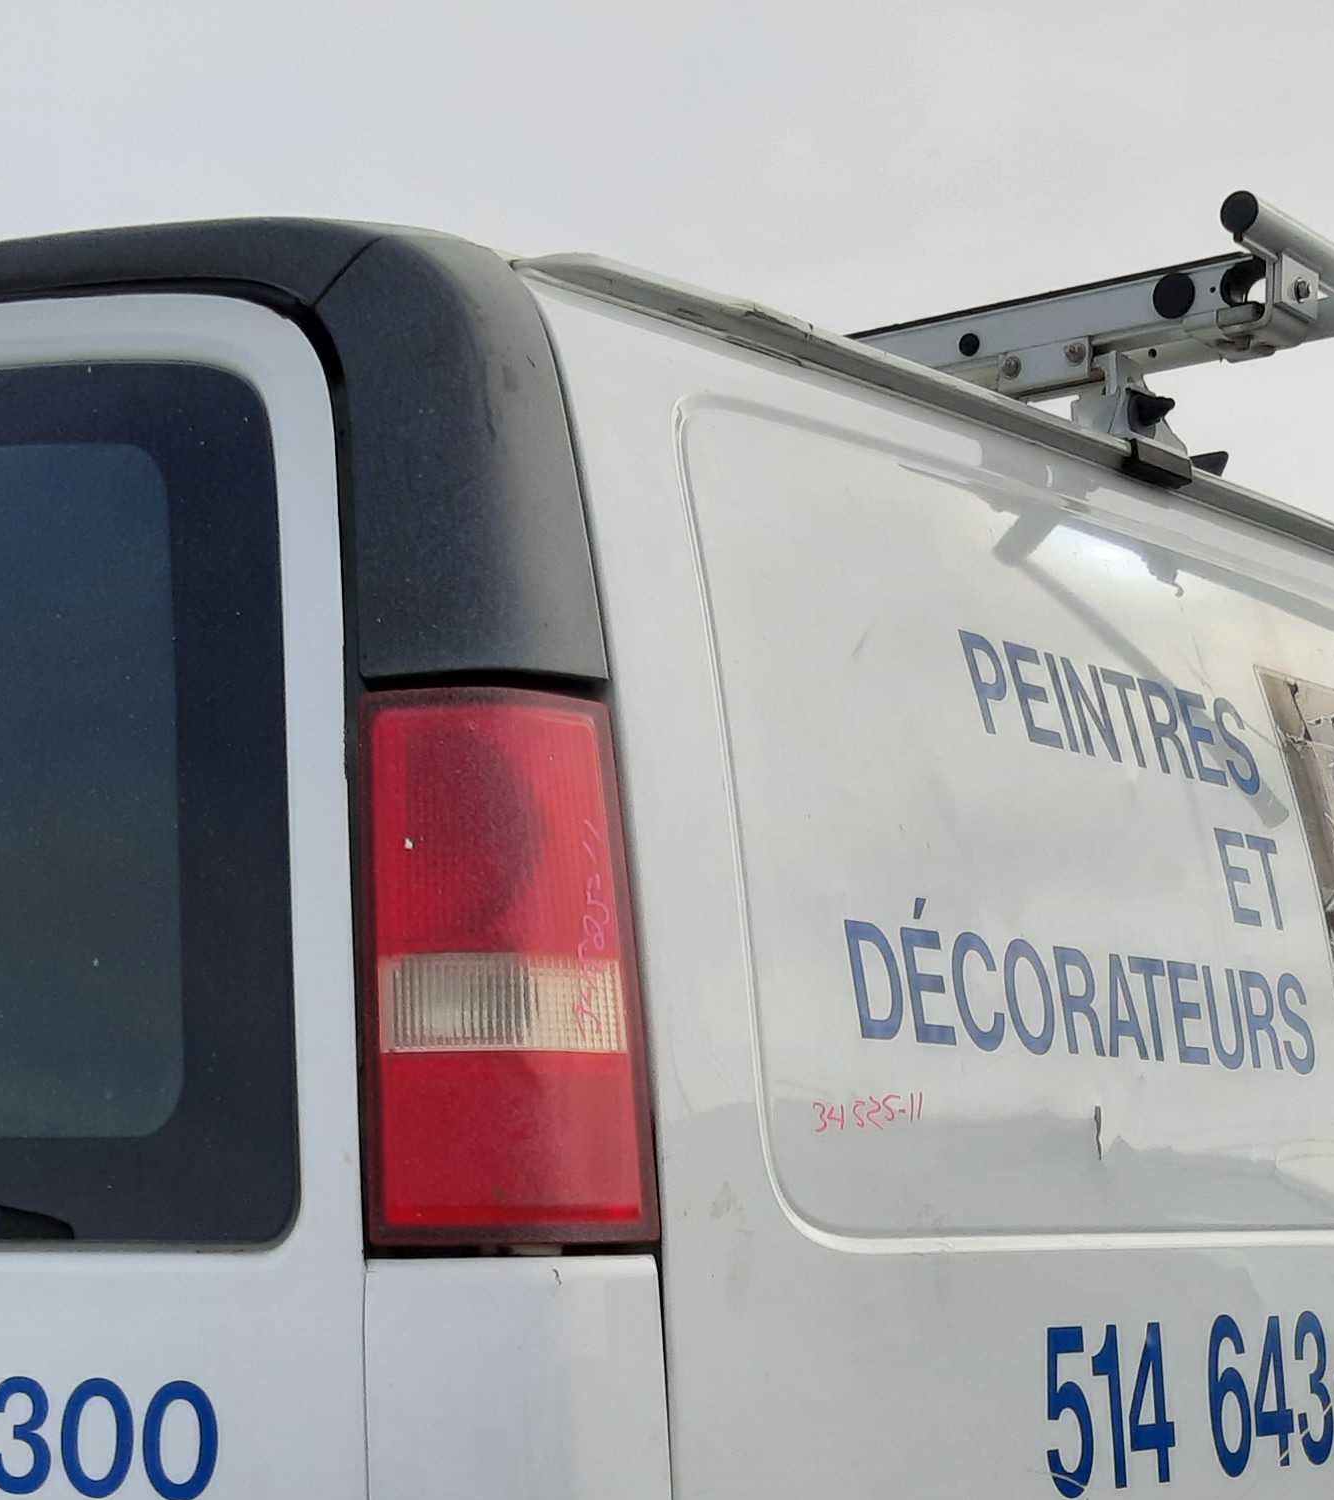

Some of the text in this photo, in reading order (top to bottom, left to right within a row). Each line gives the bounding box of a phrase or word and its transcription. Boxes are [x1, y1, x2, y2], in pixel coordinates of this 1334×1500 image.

[958, 629, 1261, 796] PEINTRES
[1214, 827, 1284, 930] ET
[843, 898, 1316, 1075] DÉCORATEURS
[1046, 1321, 1176, 1499] 514
